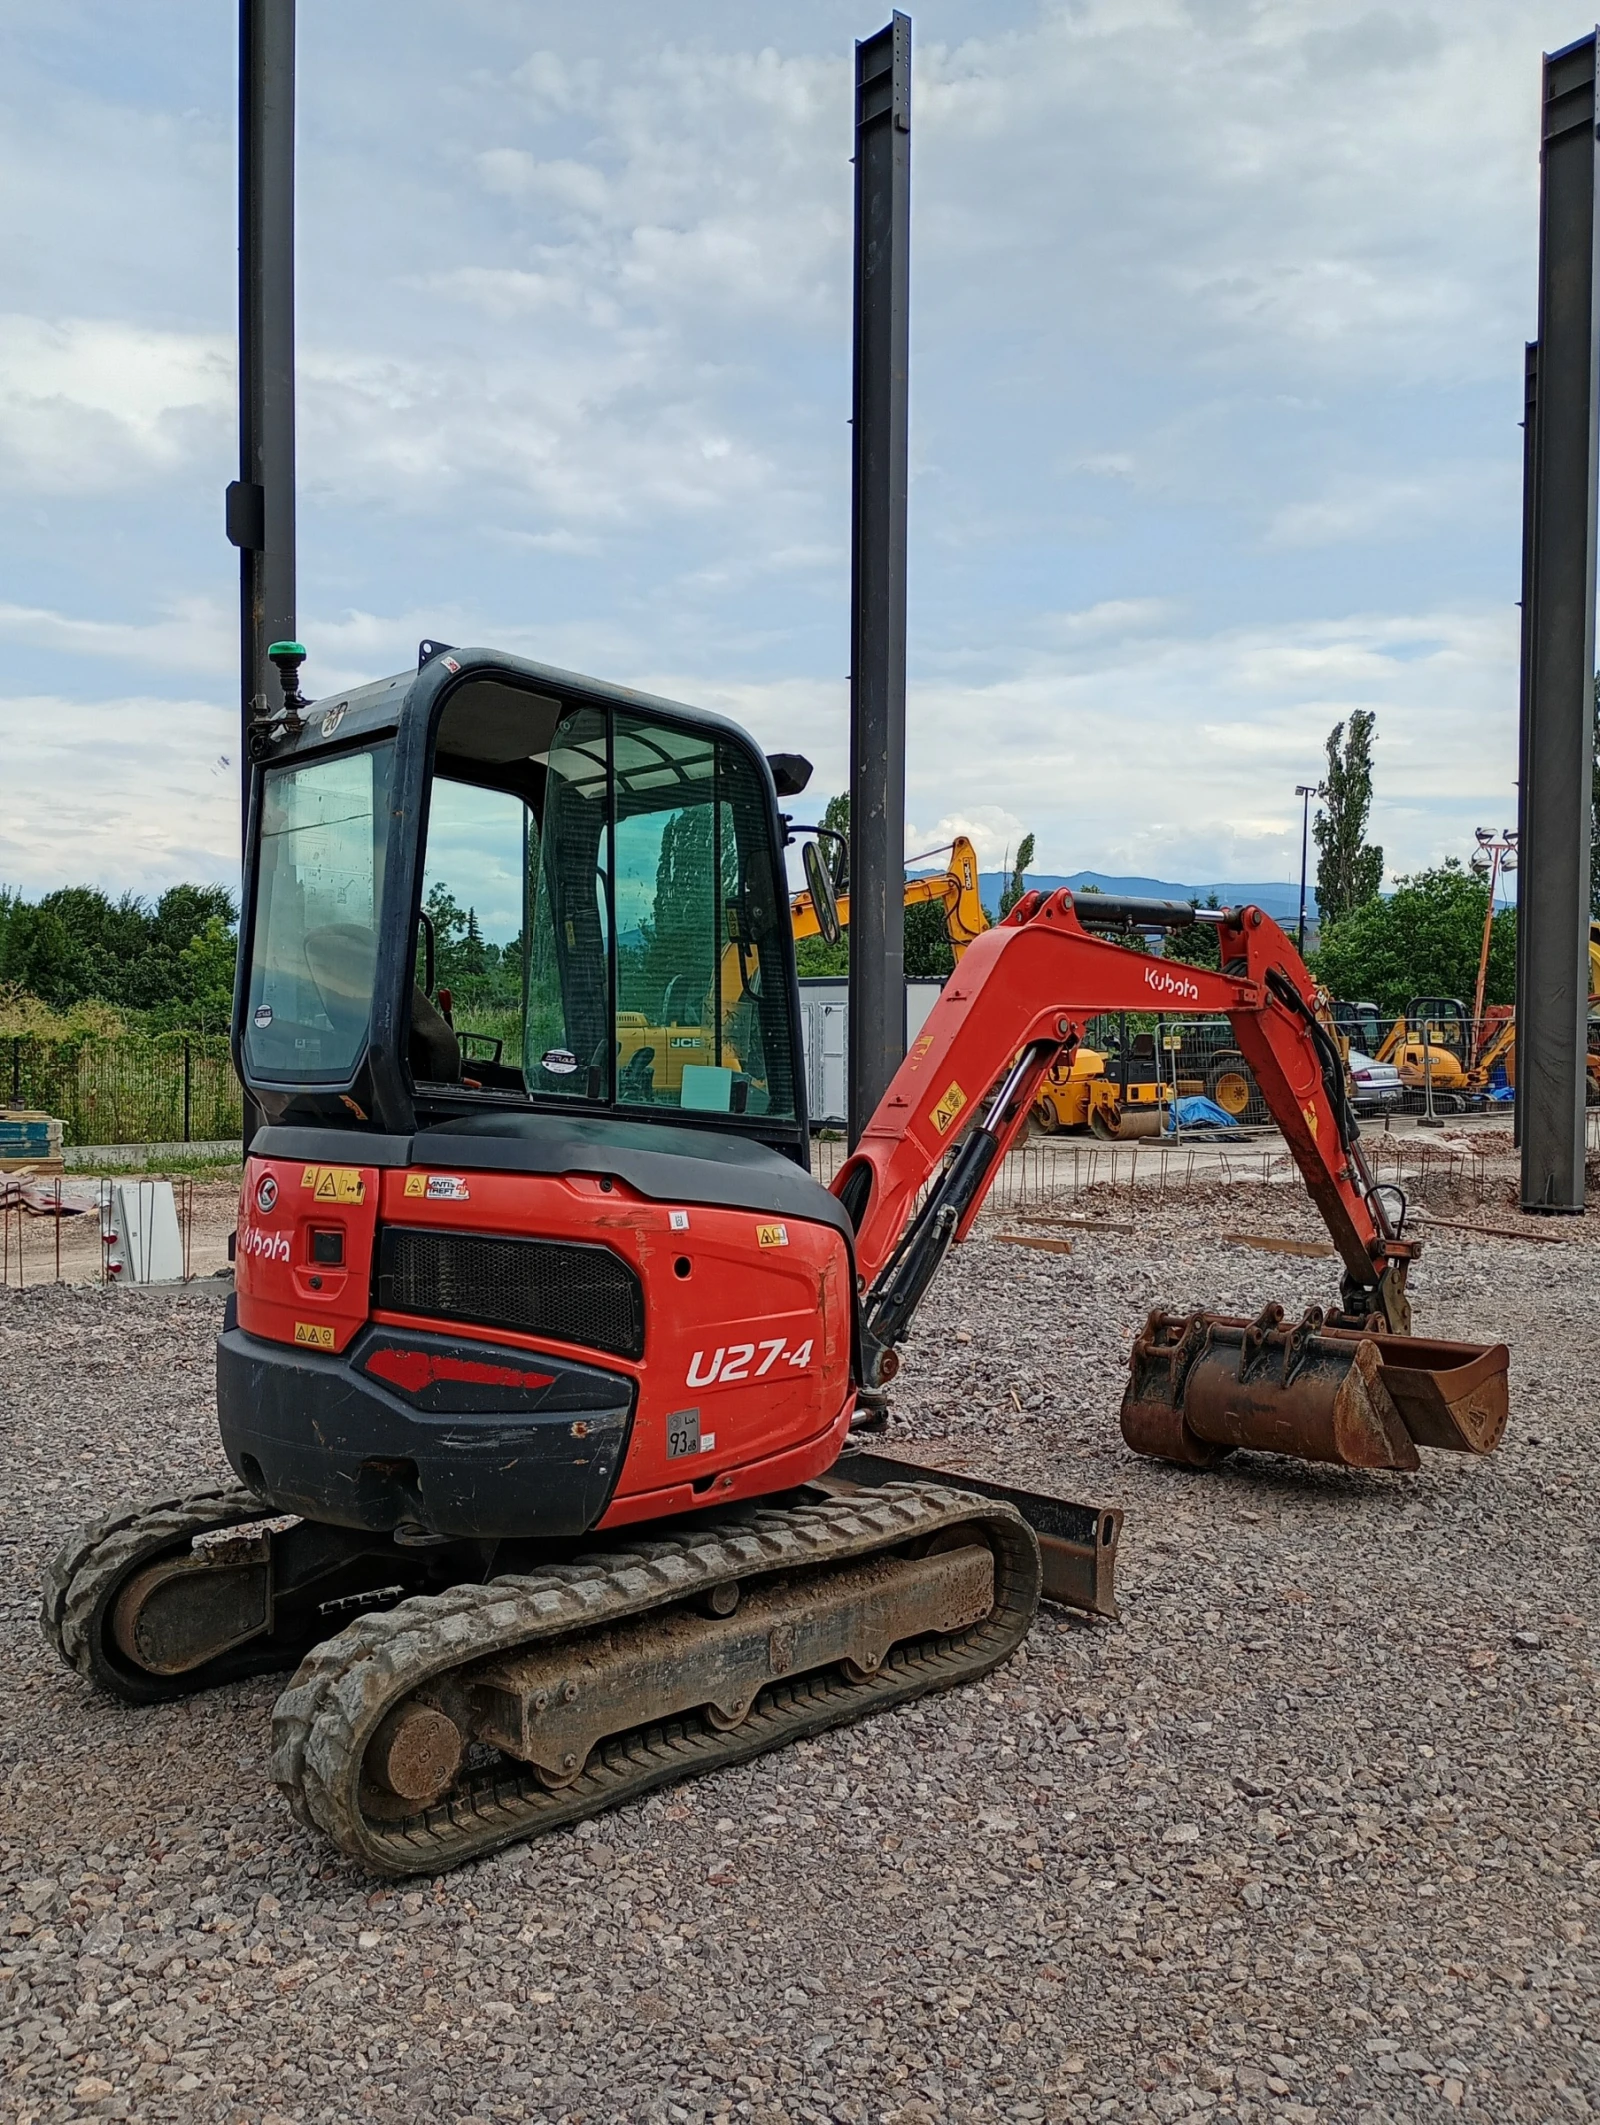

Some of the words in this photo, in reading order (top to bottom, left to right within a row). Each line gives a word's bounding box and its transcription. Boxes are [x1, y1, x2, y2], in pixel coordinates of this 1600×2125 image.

[1144, 967, 1199, 1001] Kubota
[685, 1337, 814, 1388] U27-4
[669, 1430, 688, 1455] 93
